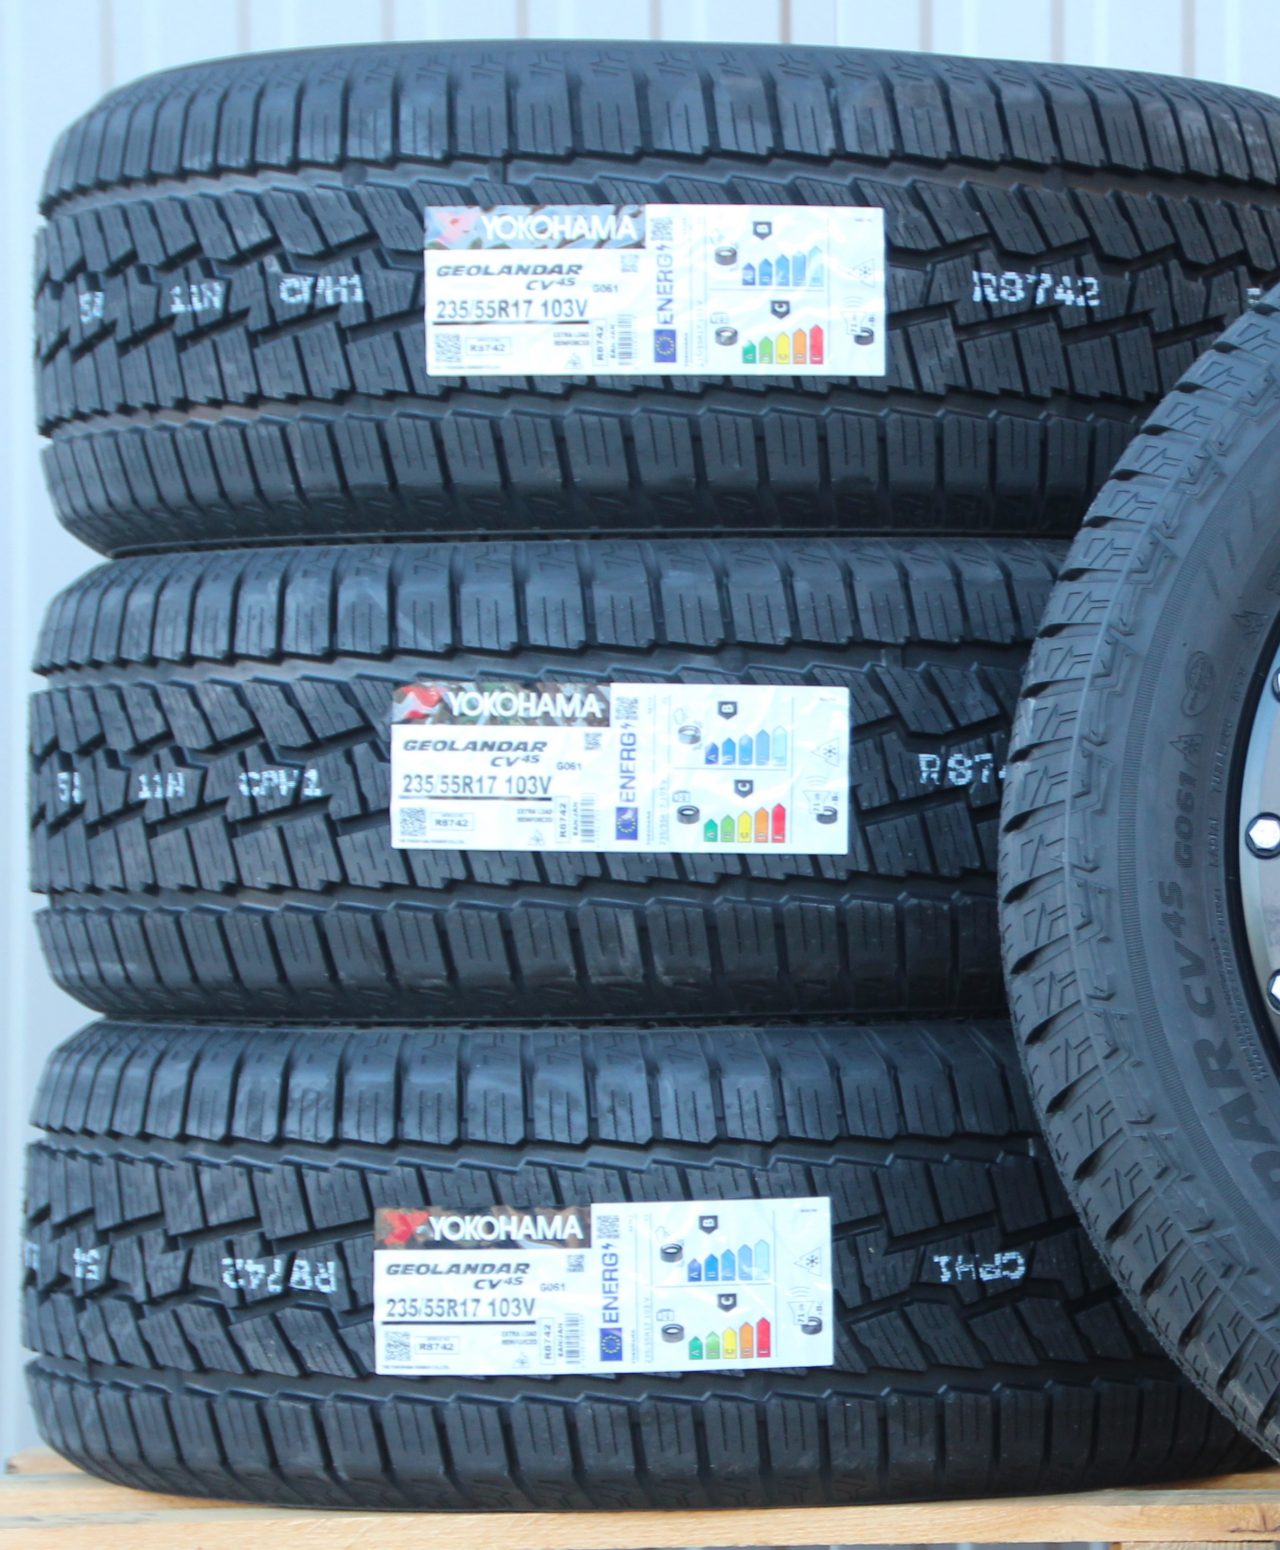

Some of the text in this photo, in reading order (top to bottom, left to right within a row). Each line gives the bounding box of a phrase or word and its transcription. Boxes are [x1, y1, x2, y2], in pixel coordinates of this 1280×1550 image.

[480, 213, 639, 241] YOKOHAMA
[754, 224, 770, 234] B
[436, 263, 584, 278] GEOLANDAR
[592, 284, 619, 293] G061
[655, 254, 674, 326] ENERG
[972, 271, 1101, 307] R8742
[541, 299, 588, 319] 103V
[773, 303, 788, 313] C
[446, 692, 603, 719] YOKOHAMA
[720, 704, 734, 714] B
[403, 739, 547, 754] GEOLANDAR
[556, 762, 582, 771] G061
[619, 732, 636, 803] ENERG
[918, 753, 1007, 785] R87
[403, 775, 552, 796] 235/55R17 103V
[738, 783, 750, 792] C
[1174, 771, 1197, 868] G061
[427, 1214, 585, 1241] YOKOHAMA
[702, 1218, 715, 1228] B
[386, 1262, 531, 1276] GEOLANDAR
[602, 1252, 620, 1324] ENERG
[386, 1298, 536, 1318] 235/55R17 103V
[721, 1296, 733, 1306] C
